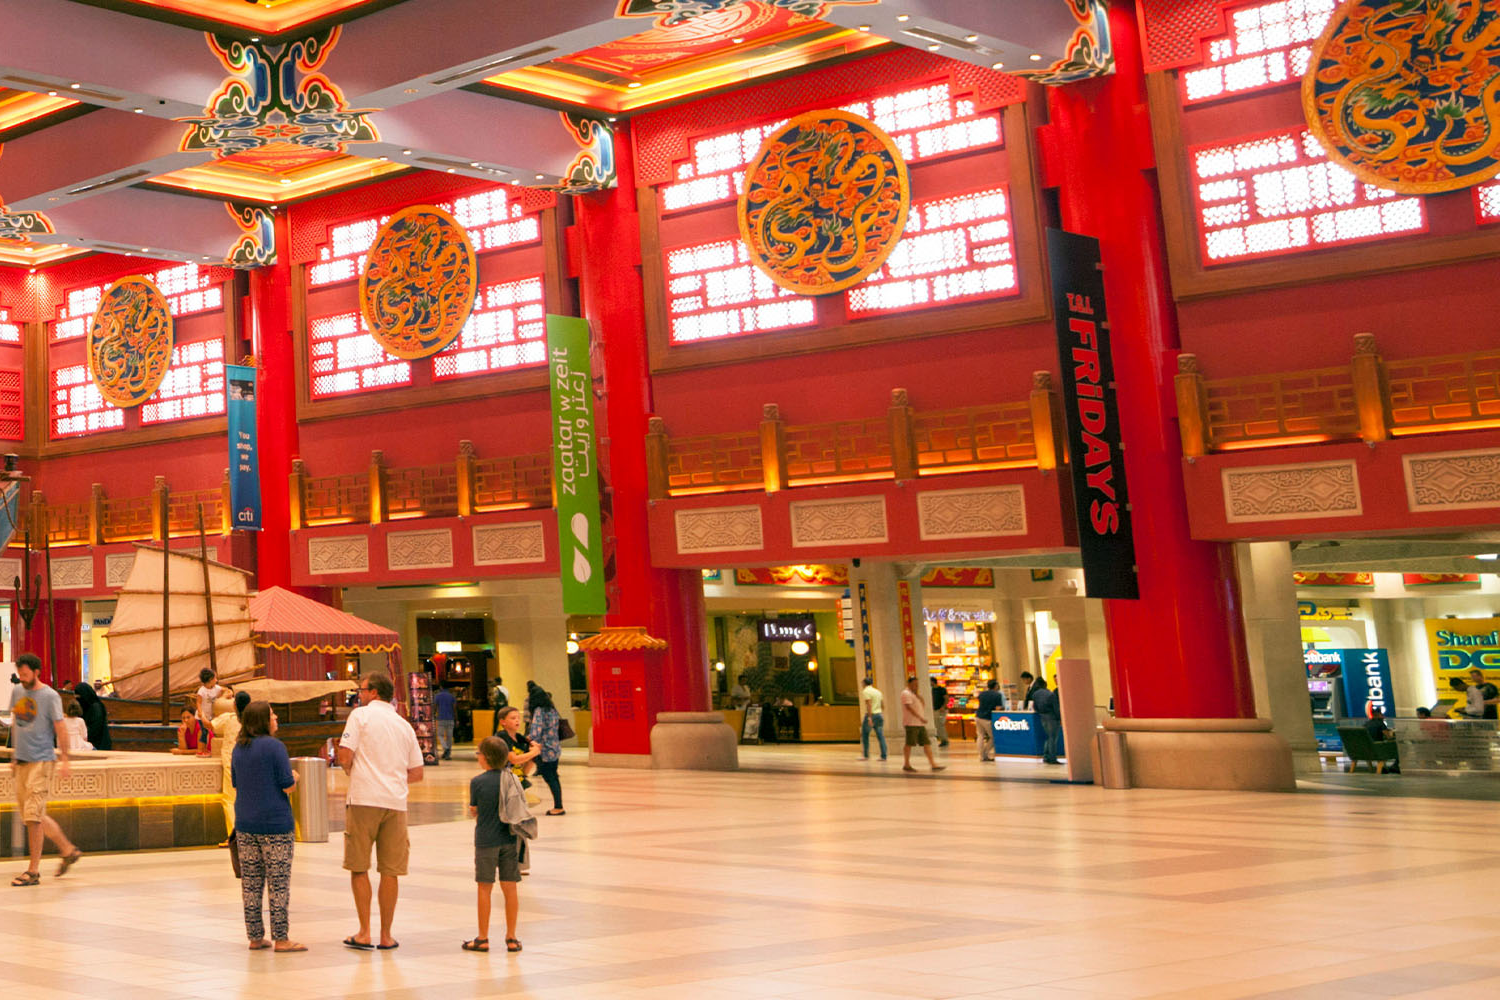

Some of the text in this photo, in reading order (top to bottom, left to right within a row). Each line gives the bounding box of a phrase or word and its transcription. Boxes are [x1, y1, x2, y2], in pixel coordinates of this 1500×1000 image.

[552, 347, 576, 496] zaatar w zeit
[238, 510, 253, 522] citi
[1437, 648, 1500, 670] DG
